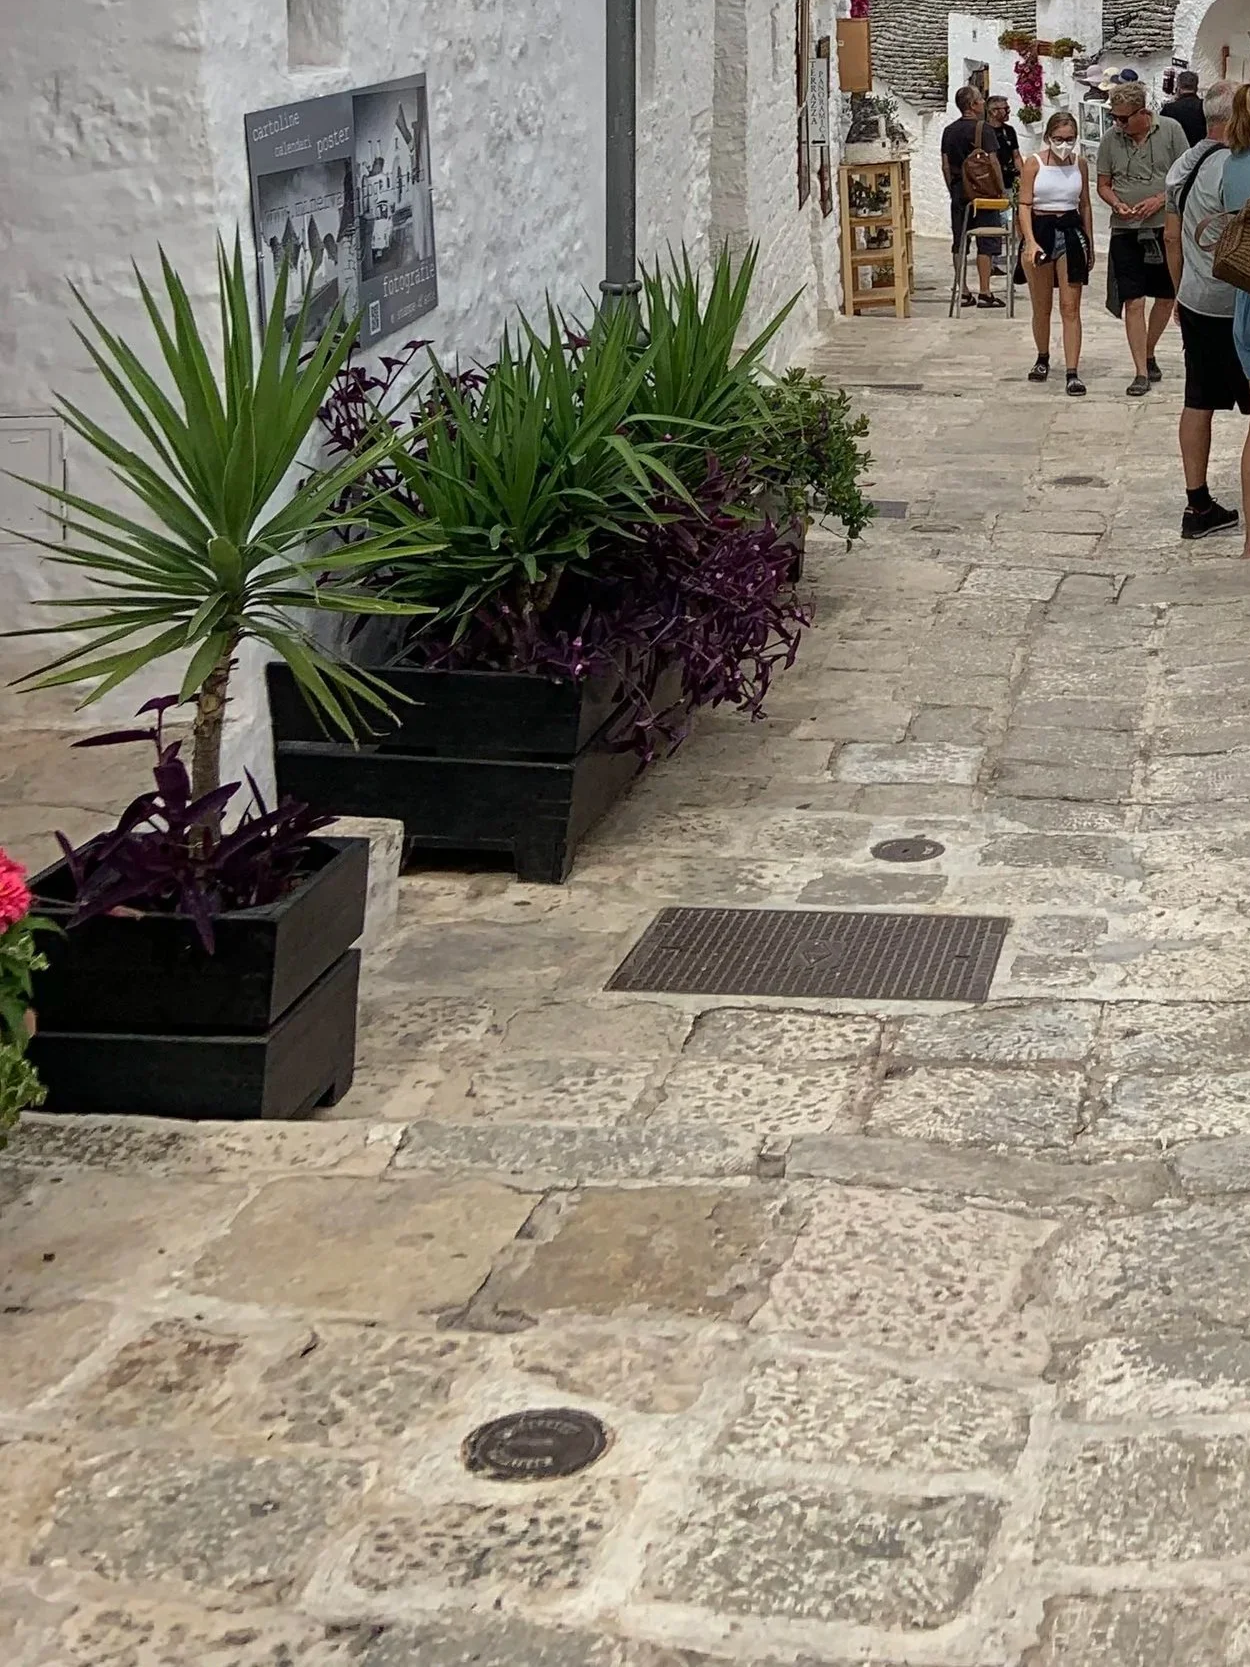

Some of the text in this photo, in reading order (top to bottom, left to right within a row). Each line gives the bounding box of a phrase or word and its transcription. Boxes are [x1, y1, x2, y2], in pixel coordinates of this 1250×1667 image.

[810, 61, 818, 125] TERRAZZA
[818, 71, 826, 139] PANORAMICA
[252, 112, 300, 142] cartoline
[273, 126, 350, 159] calendari poster
[382, 263, 436, 298] fotografie
